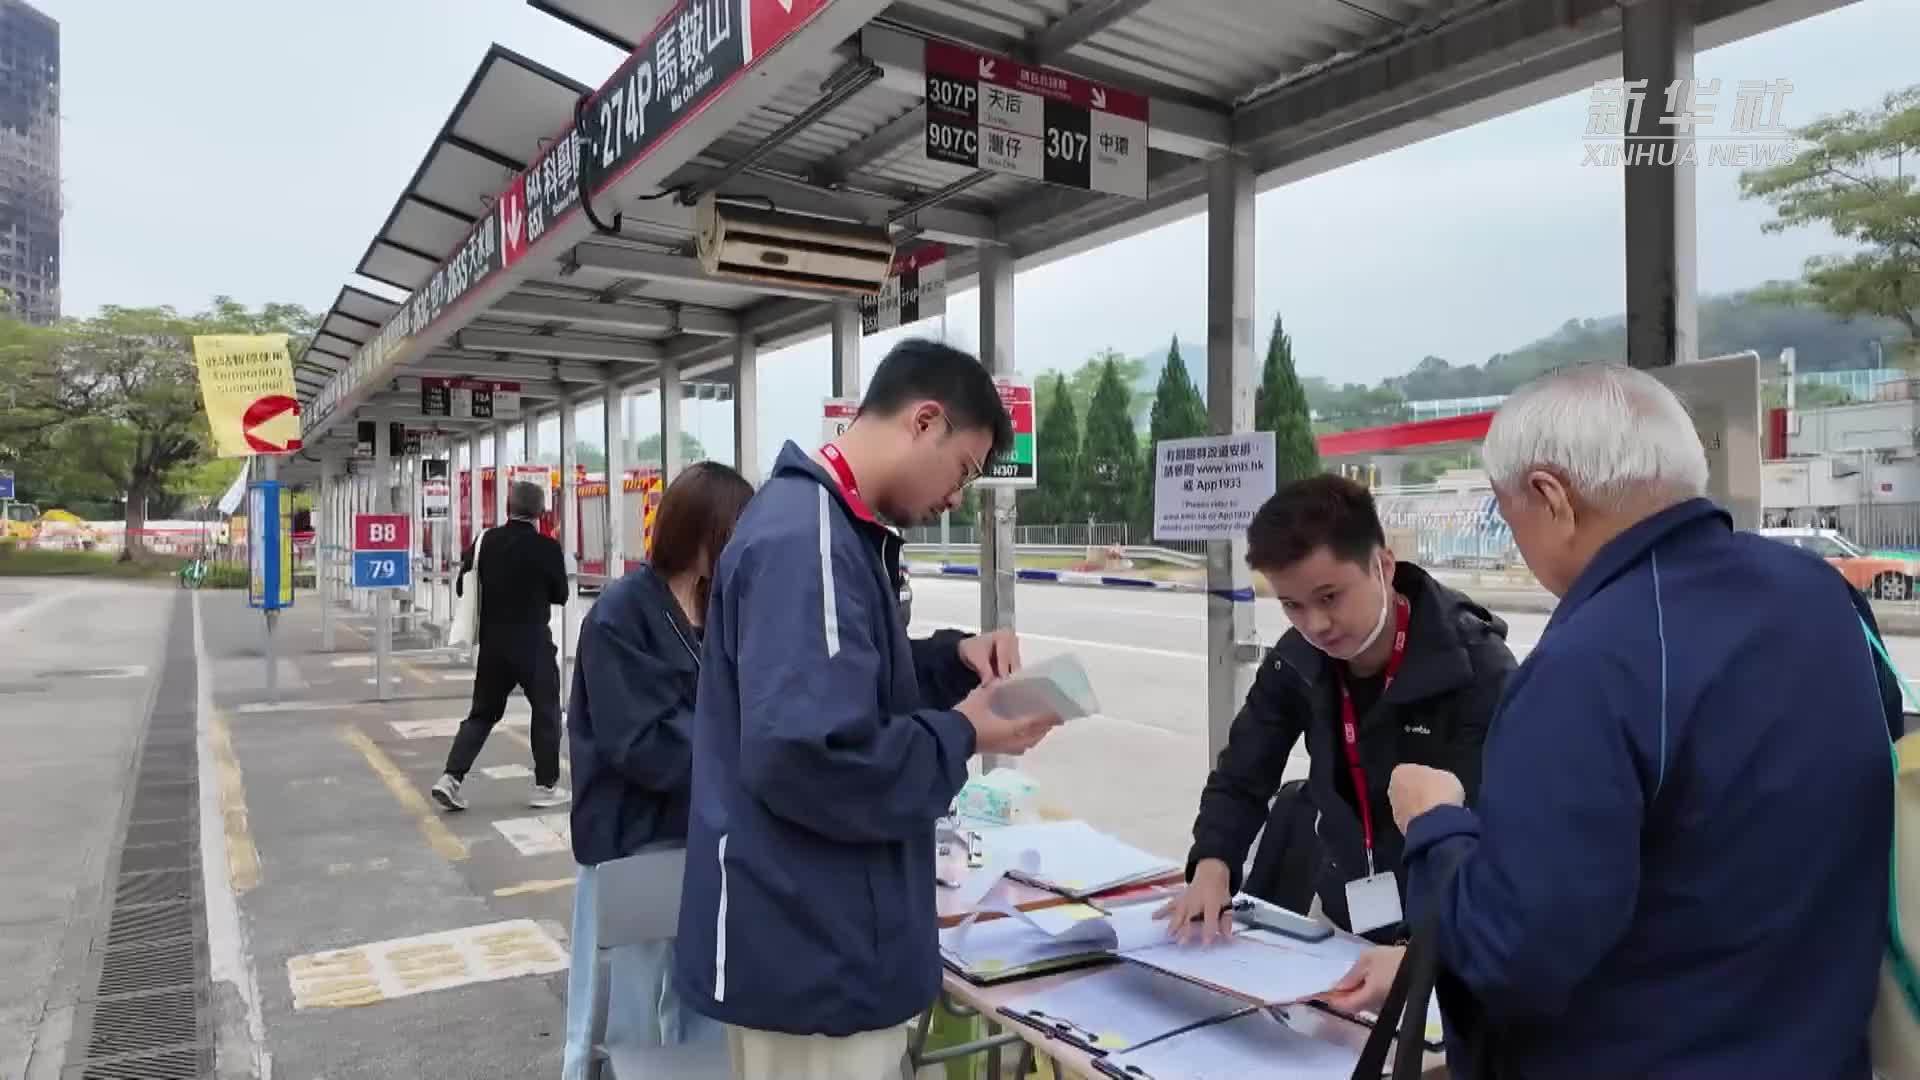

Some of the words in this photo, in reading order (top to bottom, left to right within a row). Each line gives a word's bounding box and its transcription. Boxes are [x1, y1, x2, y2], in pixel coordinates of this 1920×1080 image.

[656, 0, 730, 102] 馬鞍山
[930, 80, 976, 109] 307P
[989, 88, 1022, 113] 天后
[601, 61, 652, 168] 274P
[930, 123, 977, 154] 907C
[1047, 127, 1088, 164] 307
[1196, 477, 1241, 492] App1933
[370, 524, 396, 543] B8
[370, 561, 396, 579] 79
